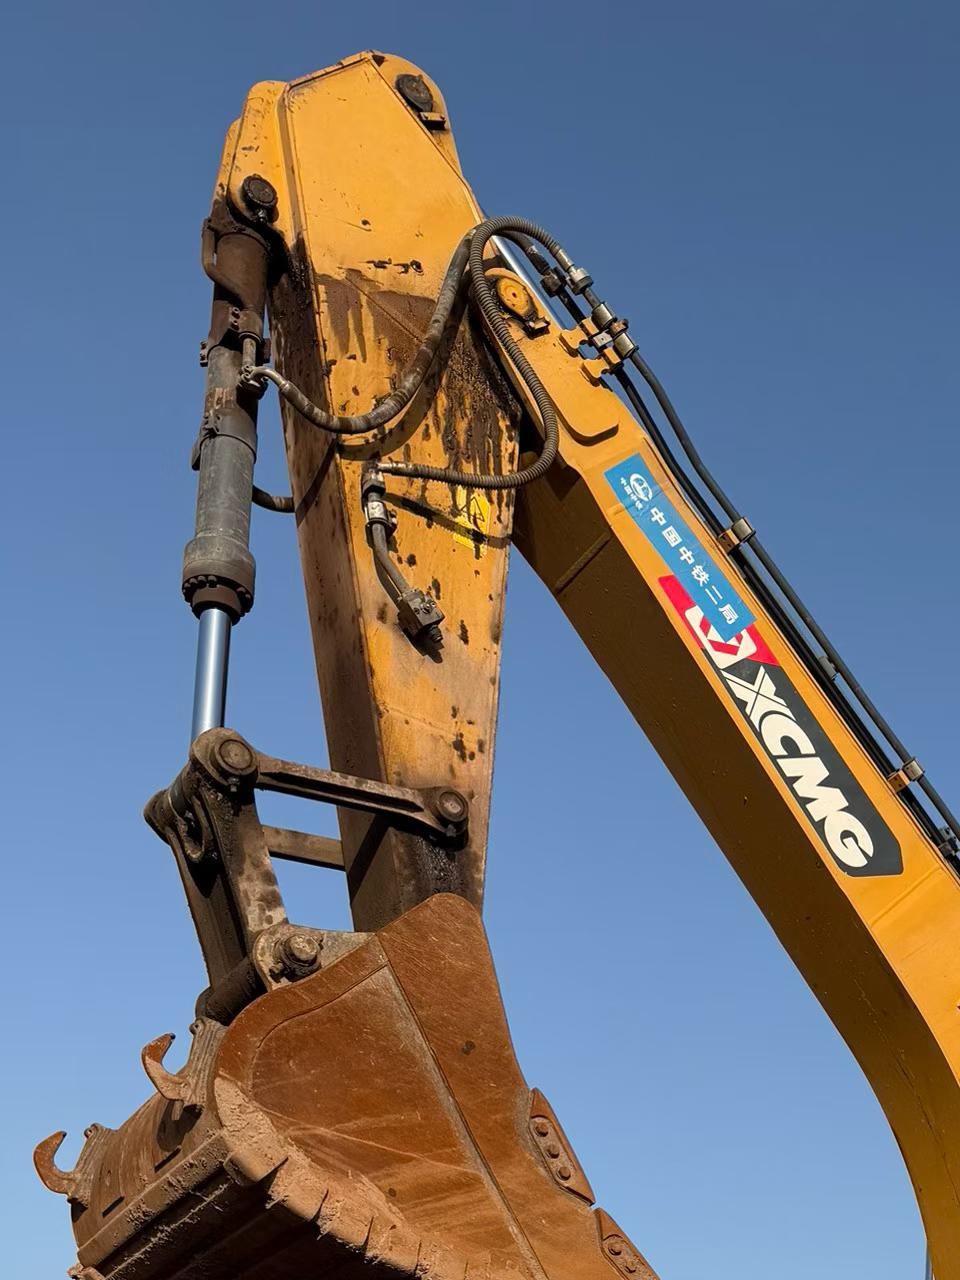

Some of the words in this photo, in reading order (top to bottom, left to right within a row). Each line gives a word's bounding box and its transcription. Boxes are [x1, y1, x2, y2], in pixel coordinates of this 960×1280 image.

[649, 506, 739, 625] 中国中铁二局
[720, 665, 875, 869] XCMG
